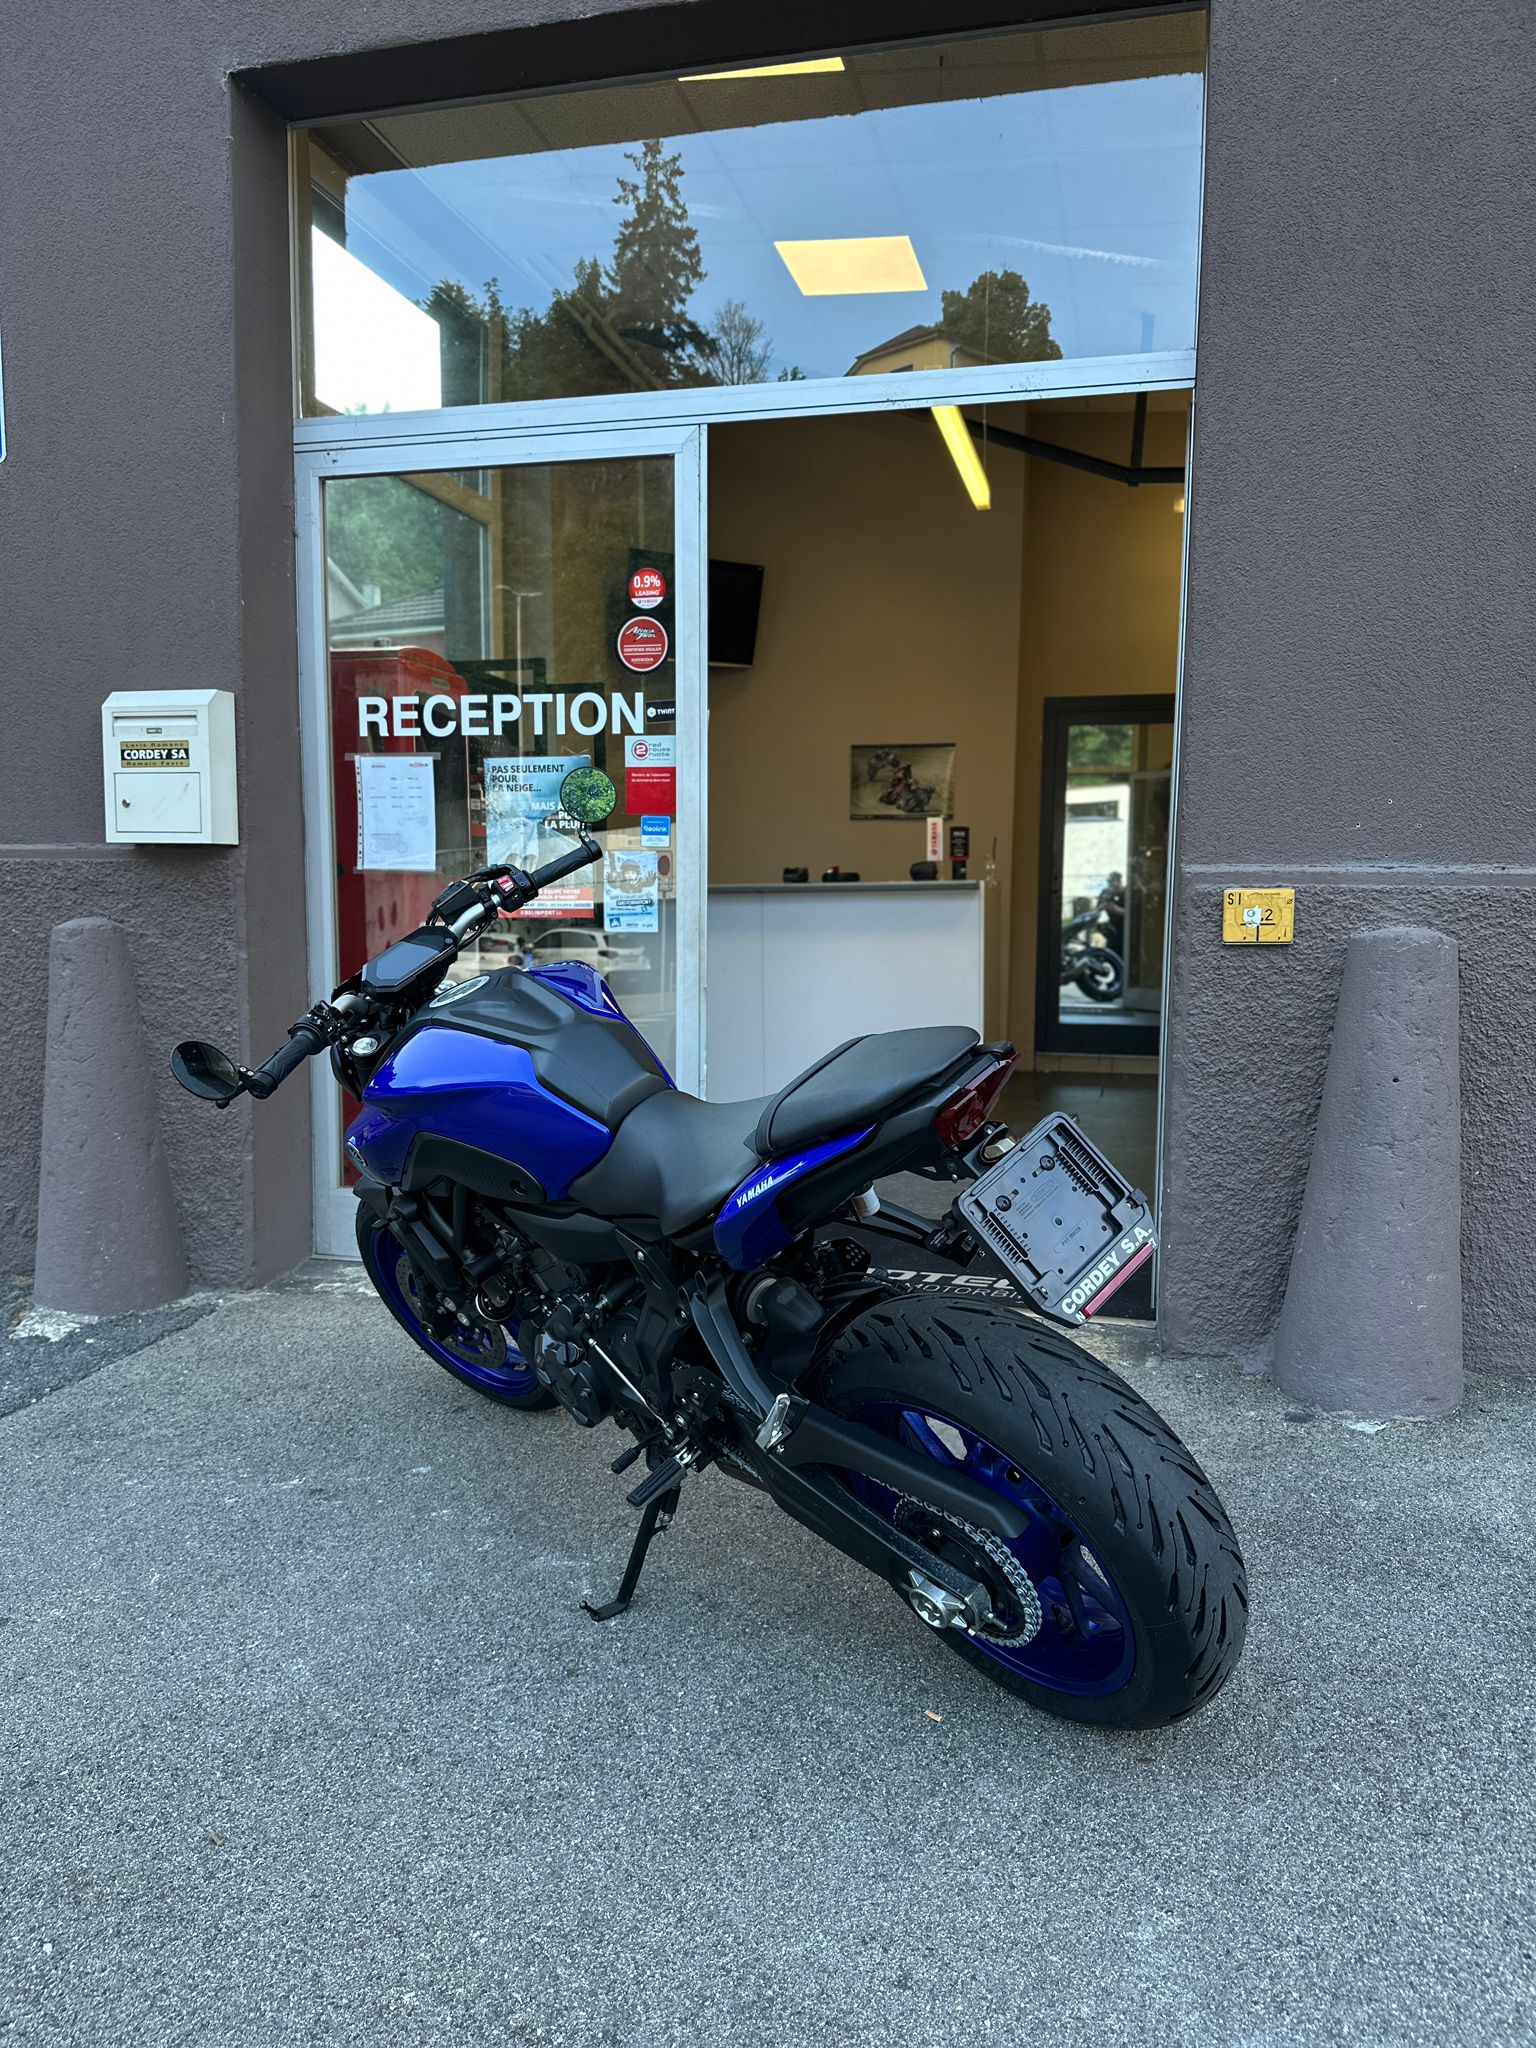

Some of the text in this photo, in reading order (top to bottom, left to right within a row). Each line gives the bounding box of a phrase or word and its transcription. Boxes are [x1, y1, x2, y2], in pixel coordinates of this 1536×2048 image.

[633, 575, 661, 588] 0.9%
[358, 691, 644, 737] RECEPTION
[123, 748, 187, 760] CORDEY SA
[491, 764, 565, 774] PAS SEULEMENT
[492, 775, 518, 783] POUR
[506, 783, 541, 792] NEIGE...
[545, 820, 558, 829] LA
[736, 1175, 774, 1208] YAMAHA
[1061, 1226, 1153, 1315] CORDEY S.A.
